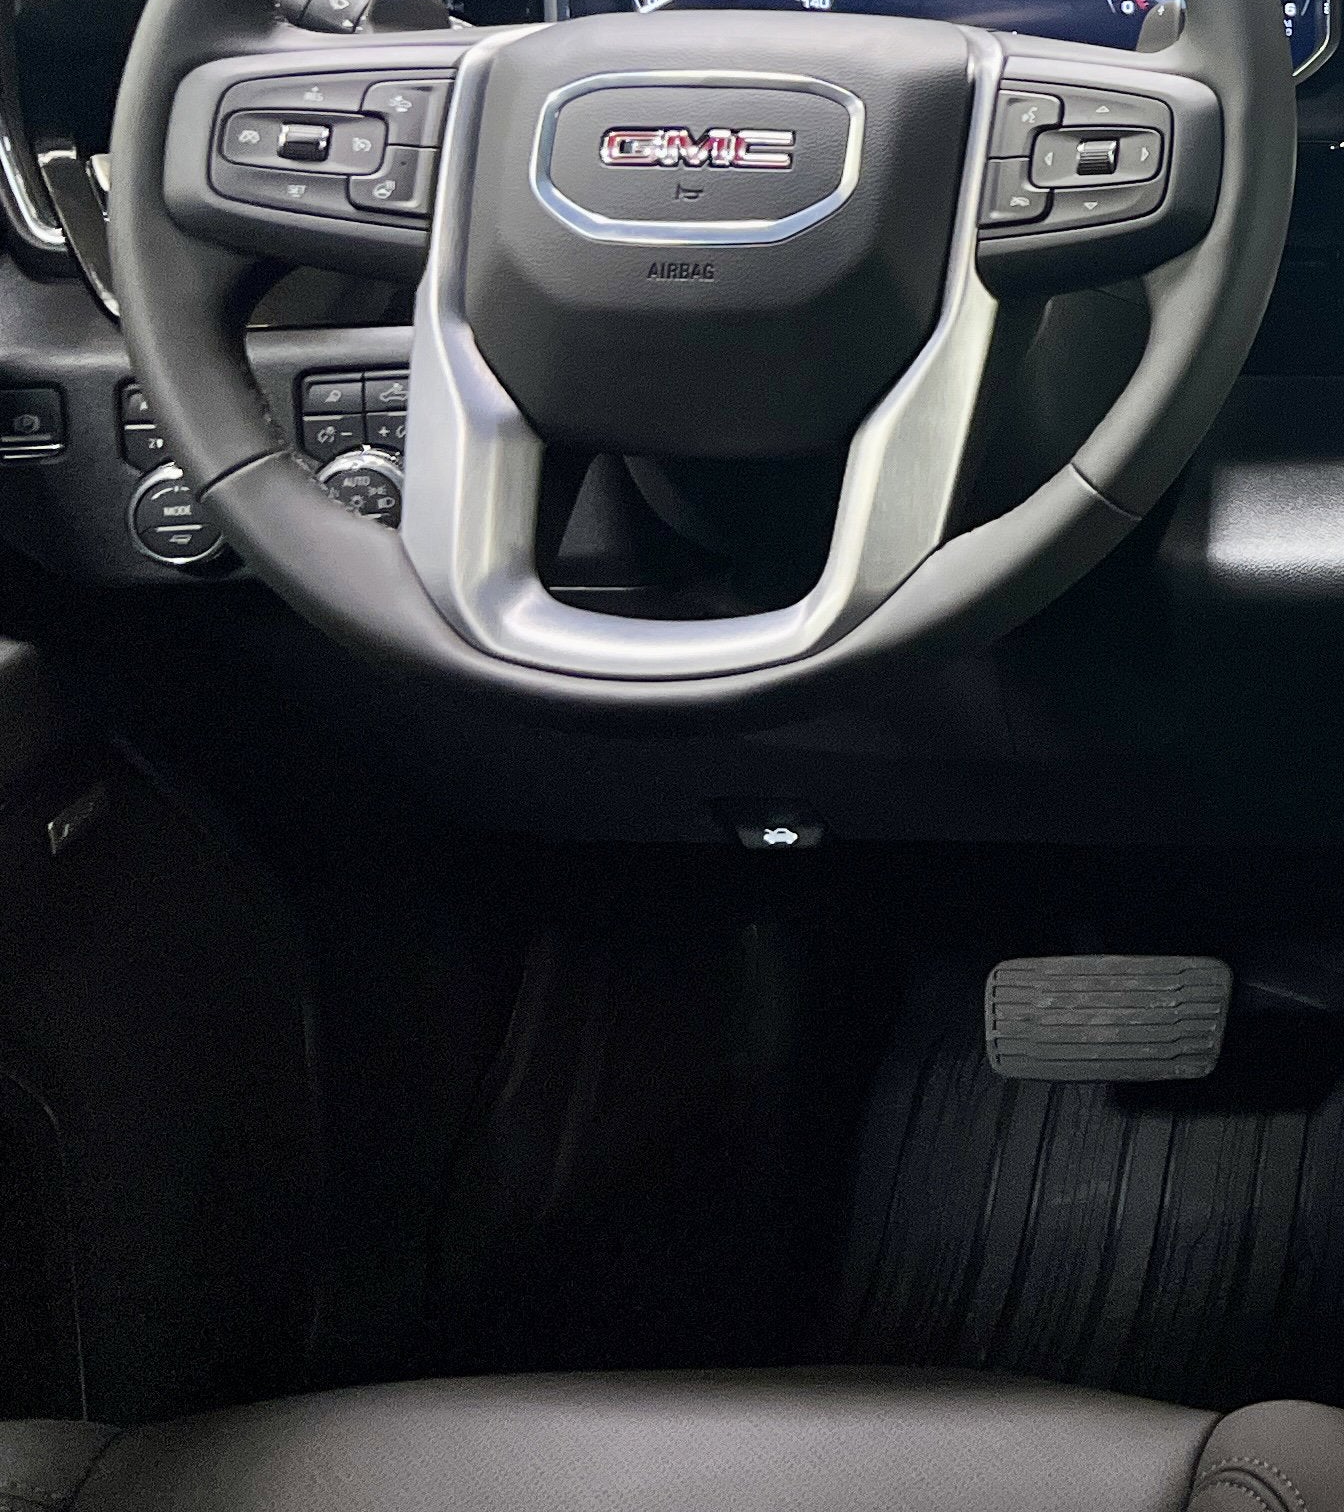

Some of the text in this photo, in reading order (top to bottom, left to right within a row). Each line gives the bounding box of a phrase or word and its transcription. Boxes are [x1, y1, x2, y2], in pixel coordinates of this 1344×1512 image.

[1120, 0, 1135, 14] 0
[1283, 2, 1297, 17] 6
[600, 126, 797, 170] GMC
[646, 261, 716, 284] AIRBAG
